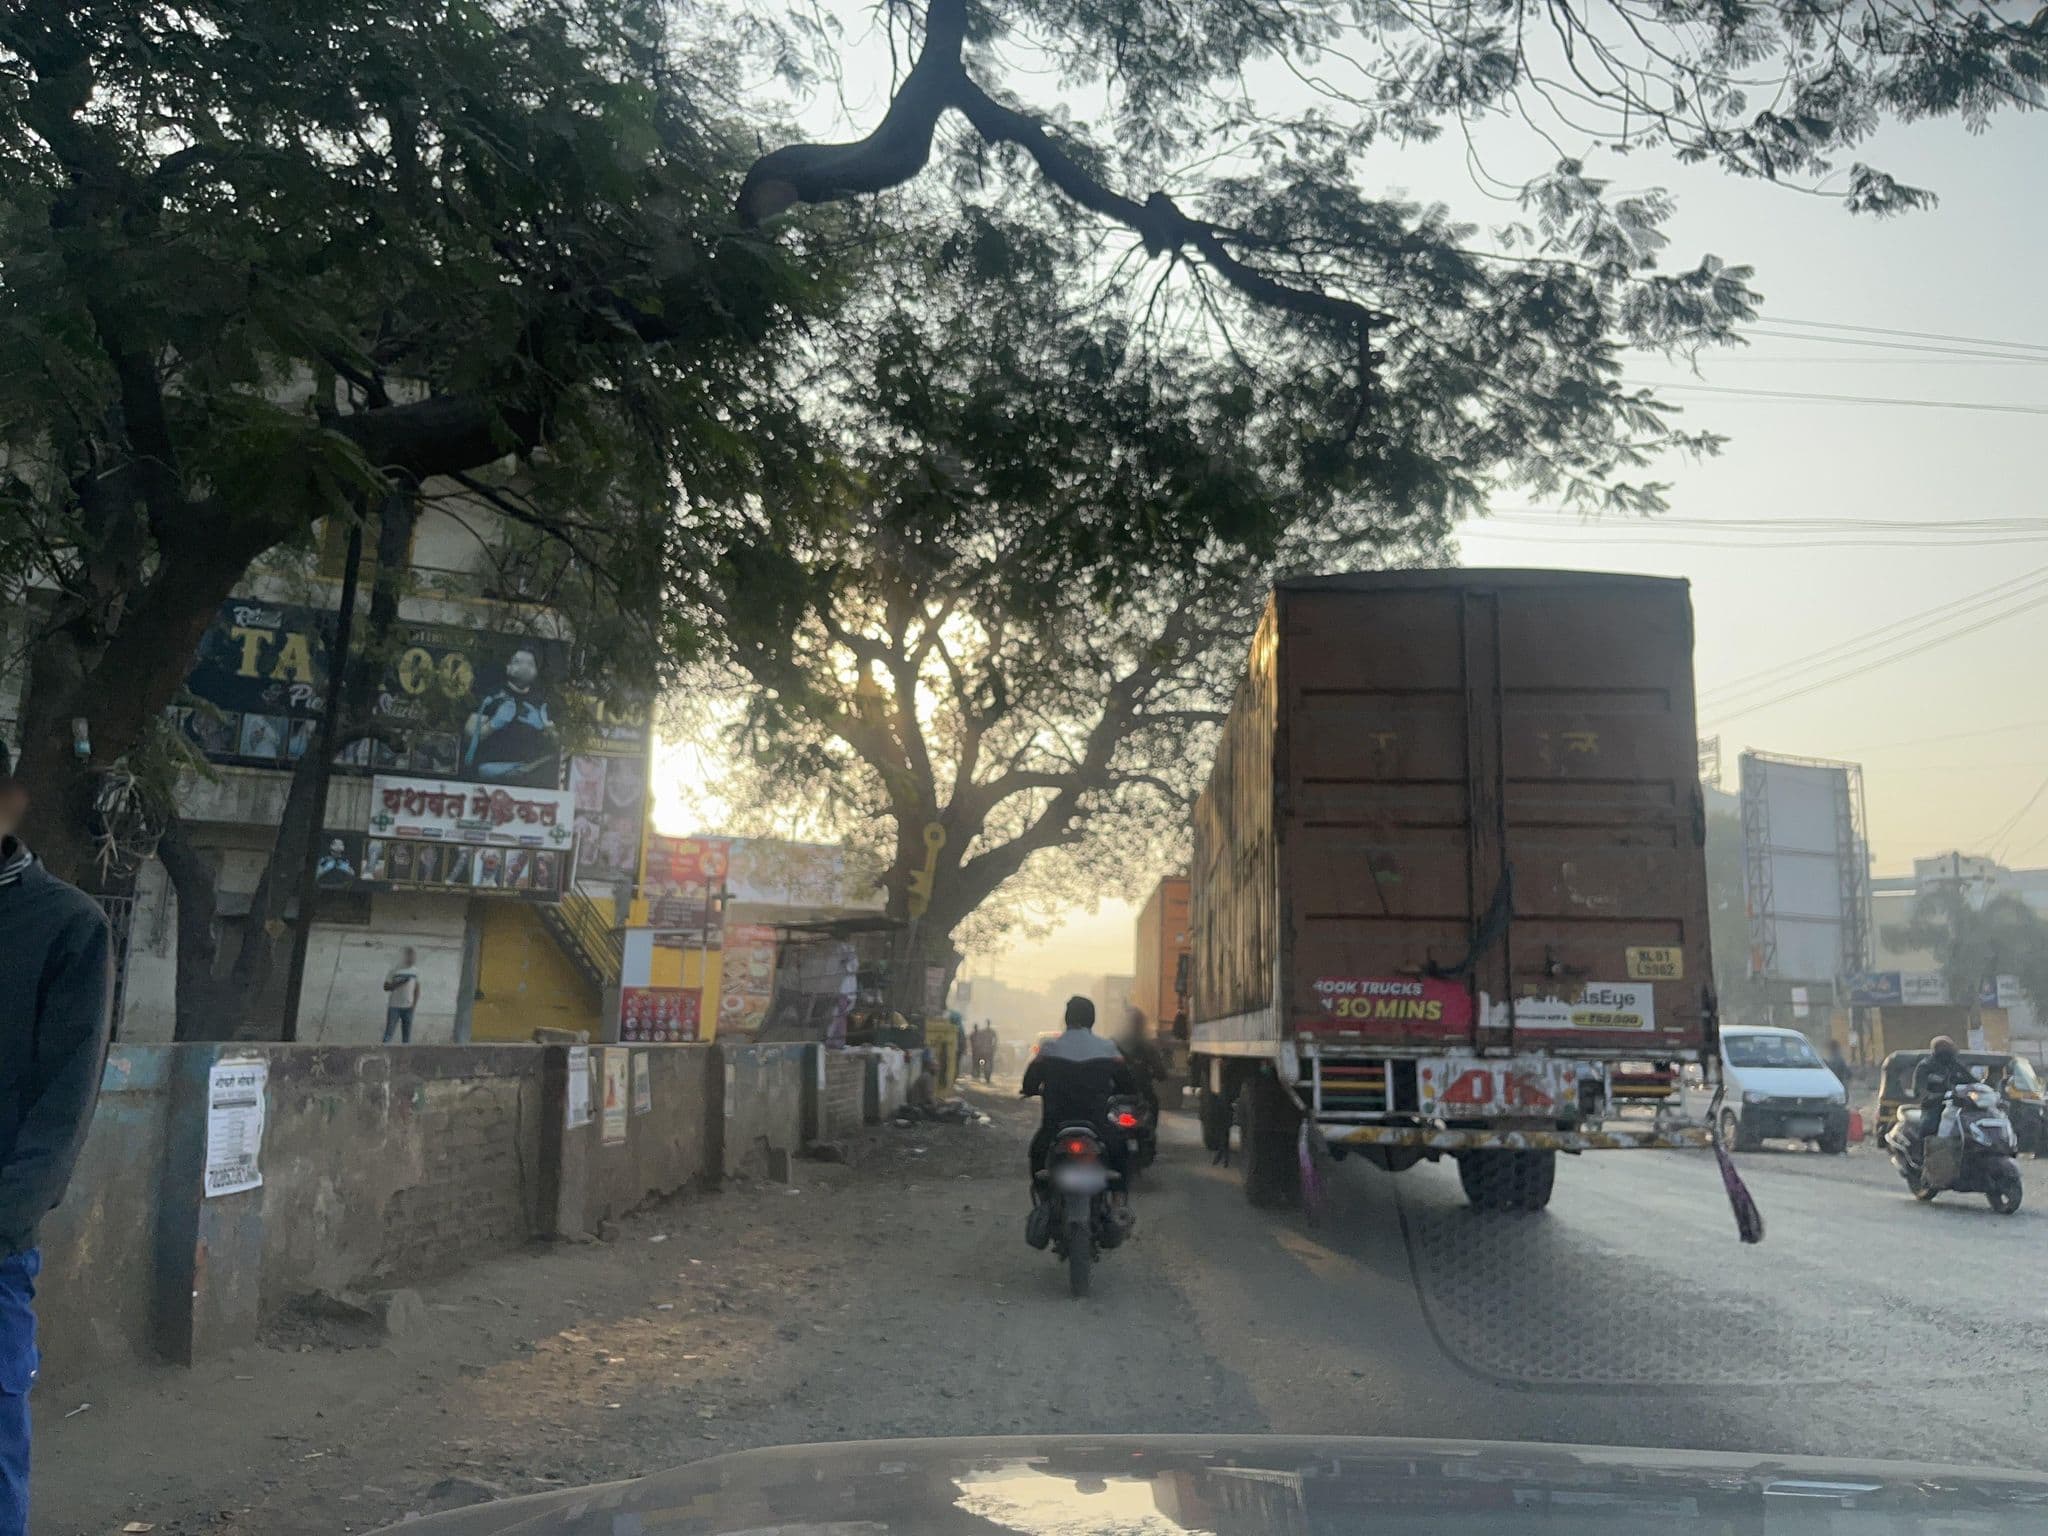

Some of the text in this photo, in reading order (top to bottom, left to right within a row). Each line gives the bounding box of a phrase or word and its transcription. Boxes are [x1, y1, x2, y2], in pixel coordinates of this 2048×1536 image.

[231, 626, 474, 700] TAOO
[1361, 981, 1425, 996] TRUCKS
[1336, 997, 1371, 1019] 30
[1375, 998, 1442, 1021] MINS
